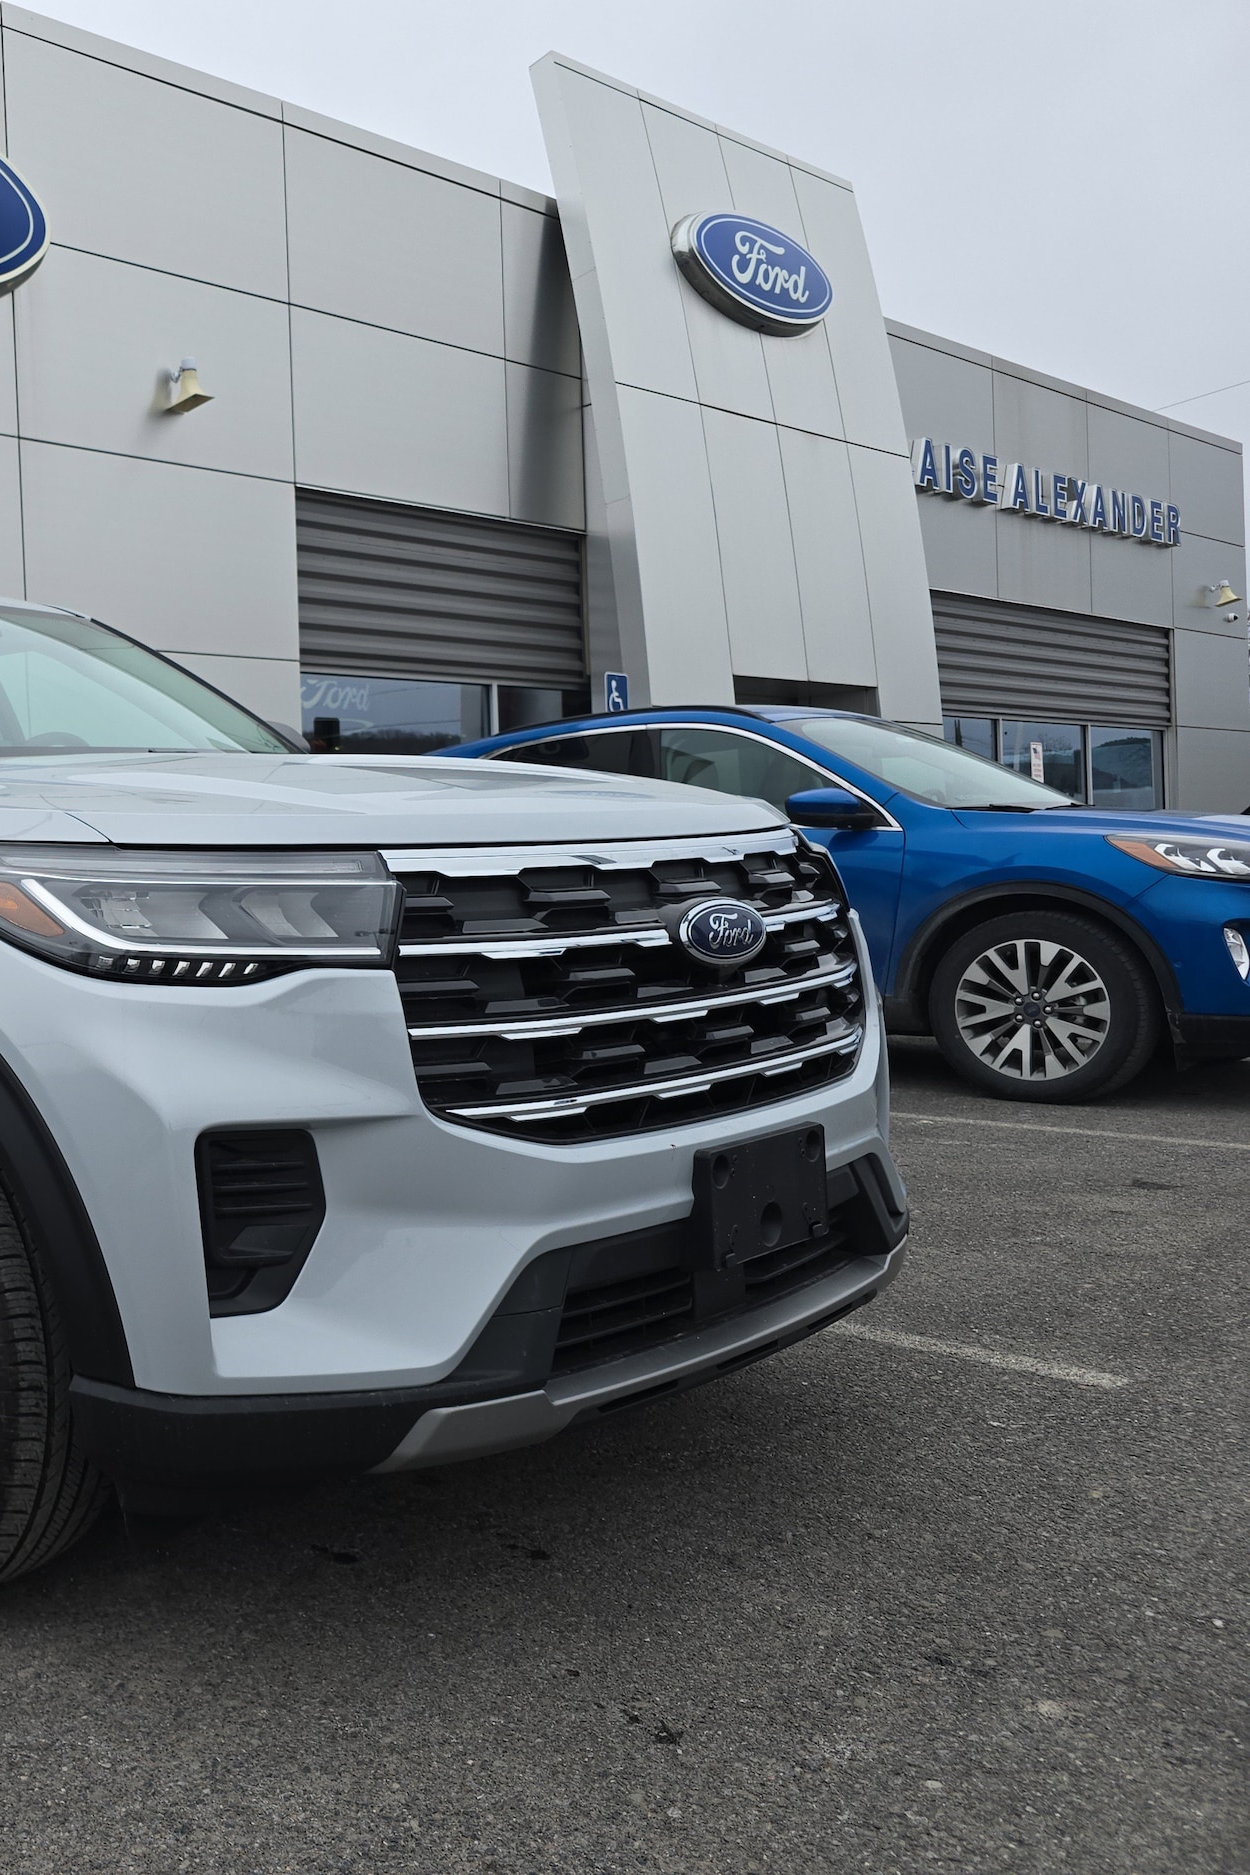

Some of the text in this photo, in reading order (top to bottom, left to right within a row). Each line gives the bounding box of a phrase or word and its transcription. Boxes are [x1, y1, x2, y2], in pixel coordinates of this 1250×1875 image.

[732, 231, 809, 303] Ford
[1005, 463, 1181, 546] ALEXANDER
[301, 679, 369, 711] Ford
[709, 913, 754, 947] Ford
